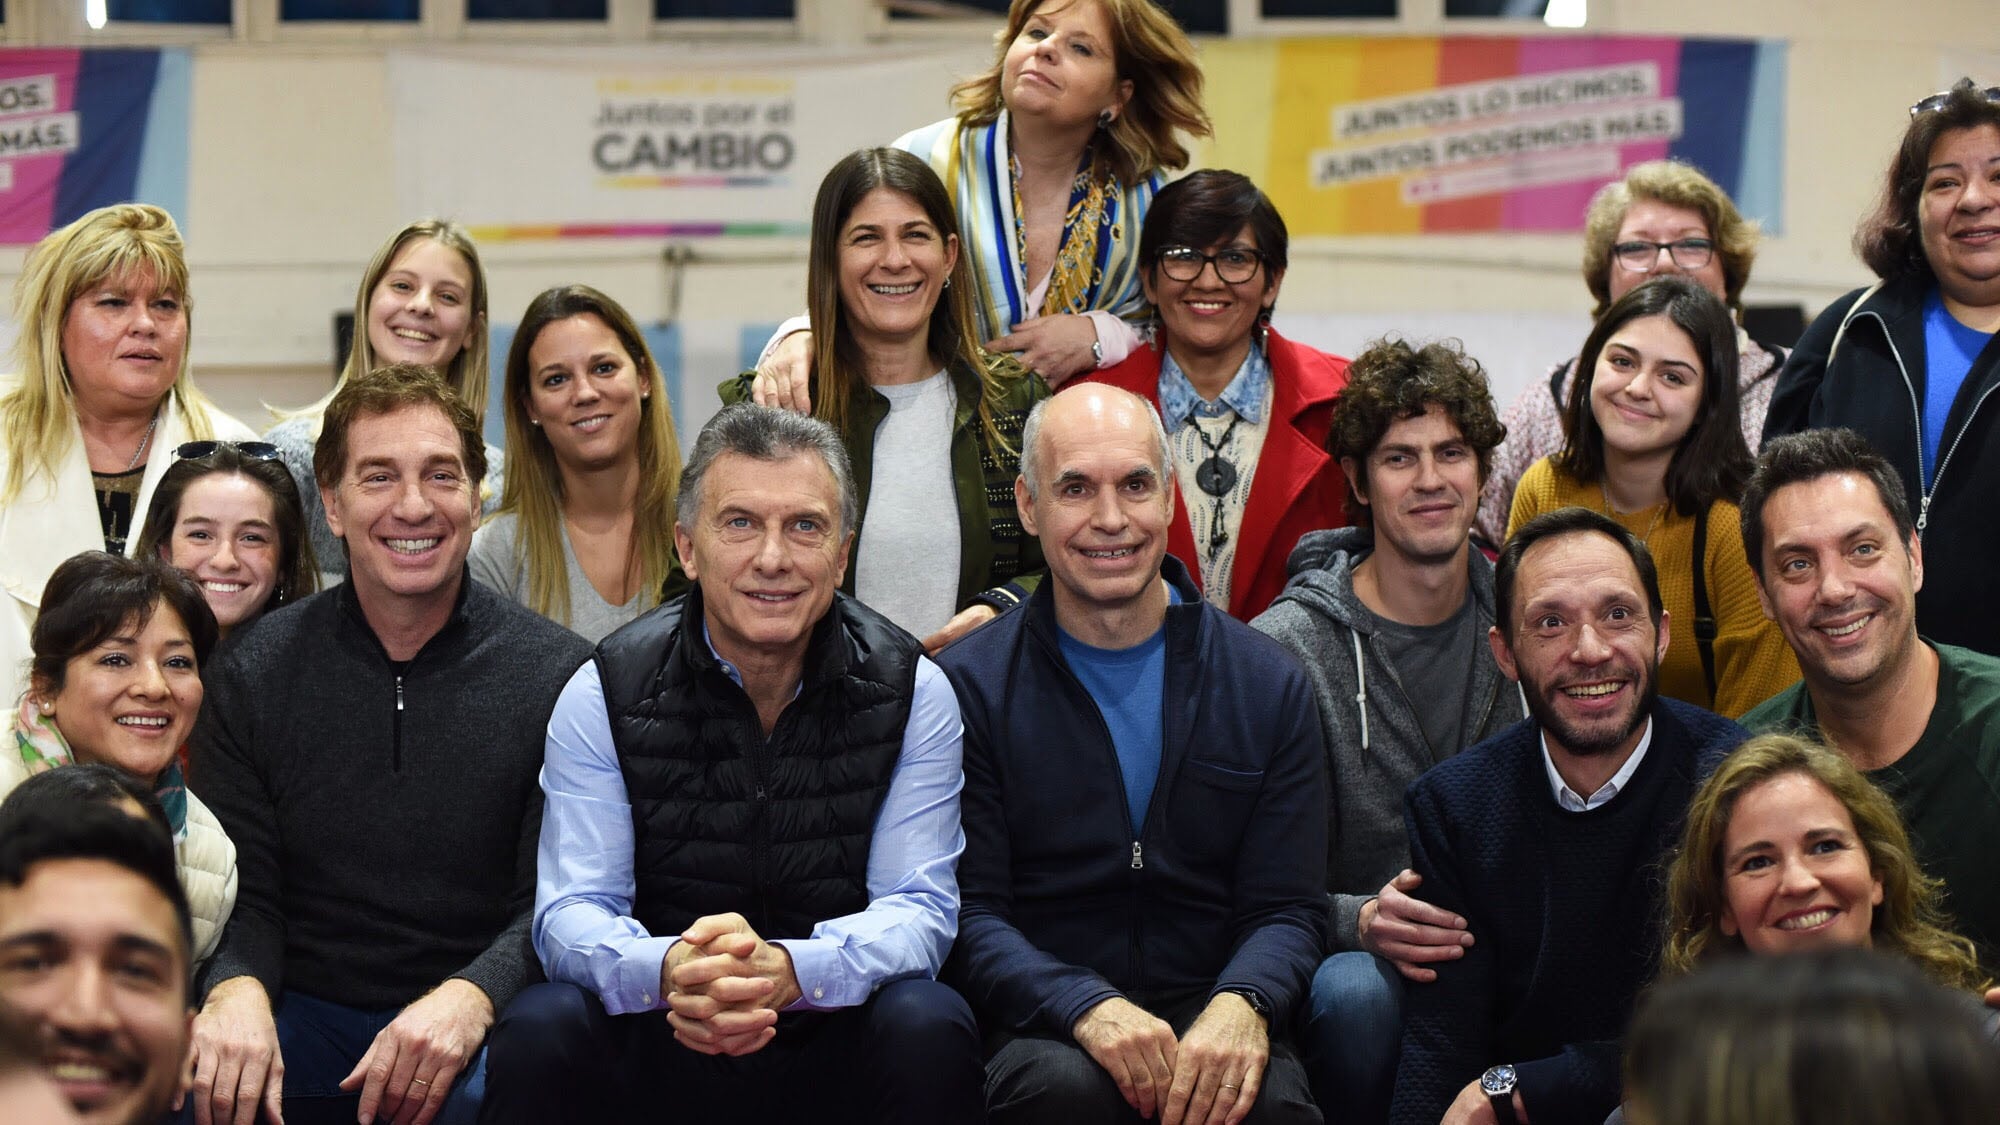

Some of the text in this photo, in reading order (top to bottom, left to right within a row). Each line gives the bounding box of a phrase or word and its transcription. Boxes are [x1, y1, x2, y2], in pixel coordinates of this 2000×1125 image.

[594, 101, 796, 127] Juntos por el
[1343, 99, 1459, 136] JUNTOS
[1469, 88, 1513, 117] LO
[592, 133, 795, 172] CAMBIO
[1318, 147, 1435, 186] JUNTOS
[1446, 127, 1595, 163] PODEMOS
